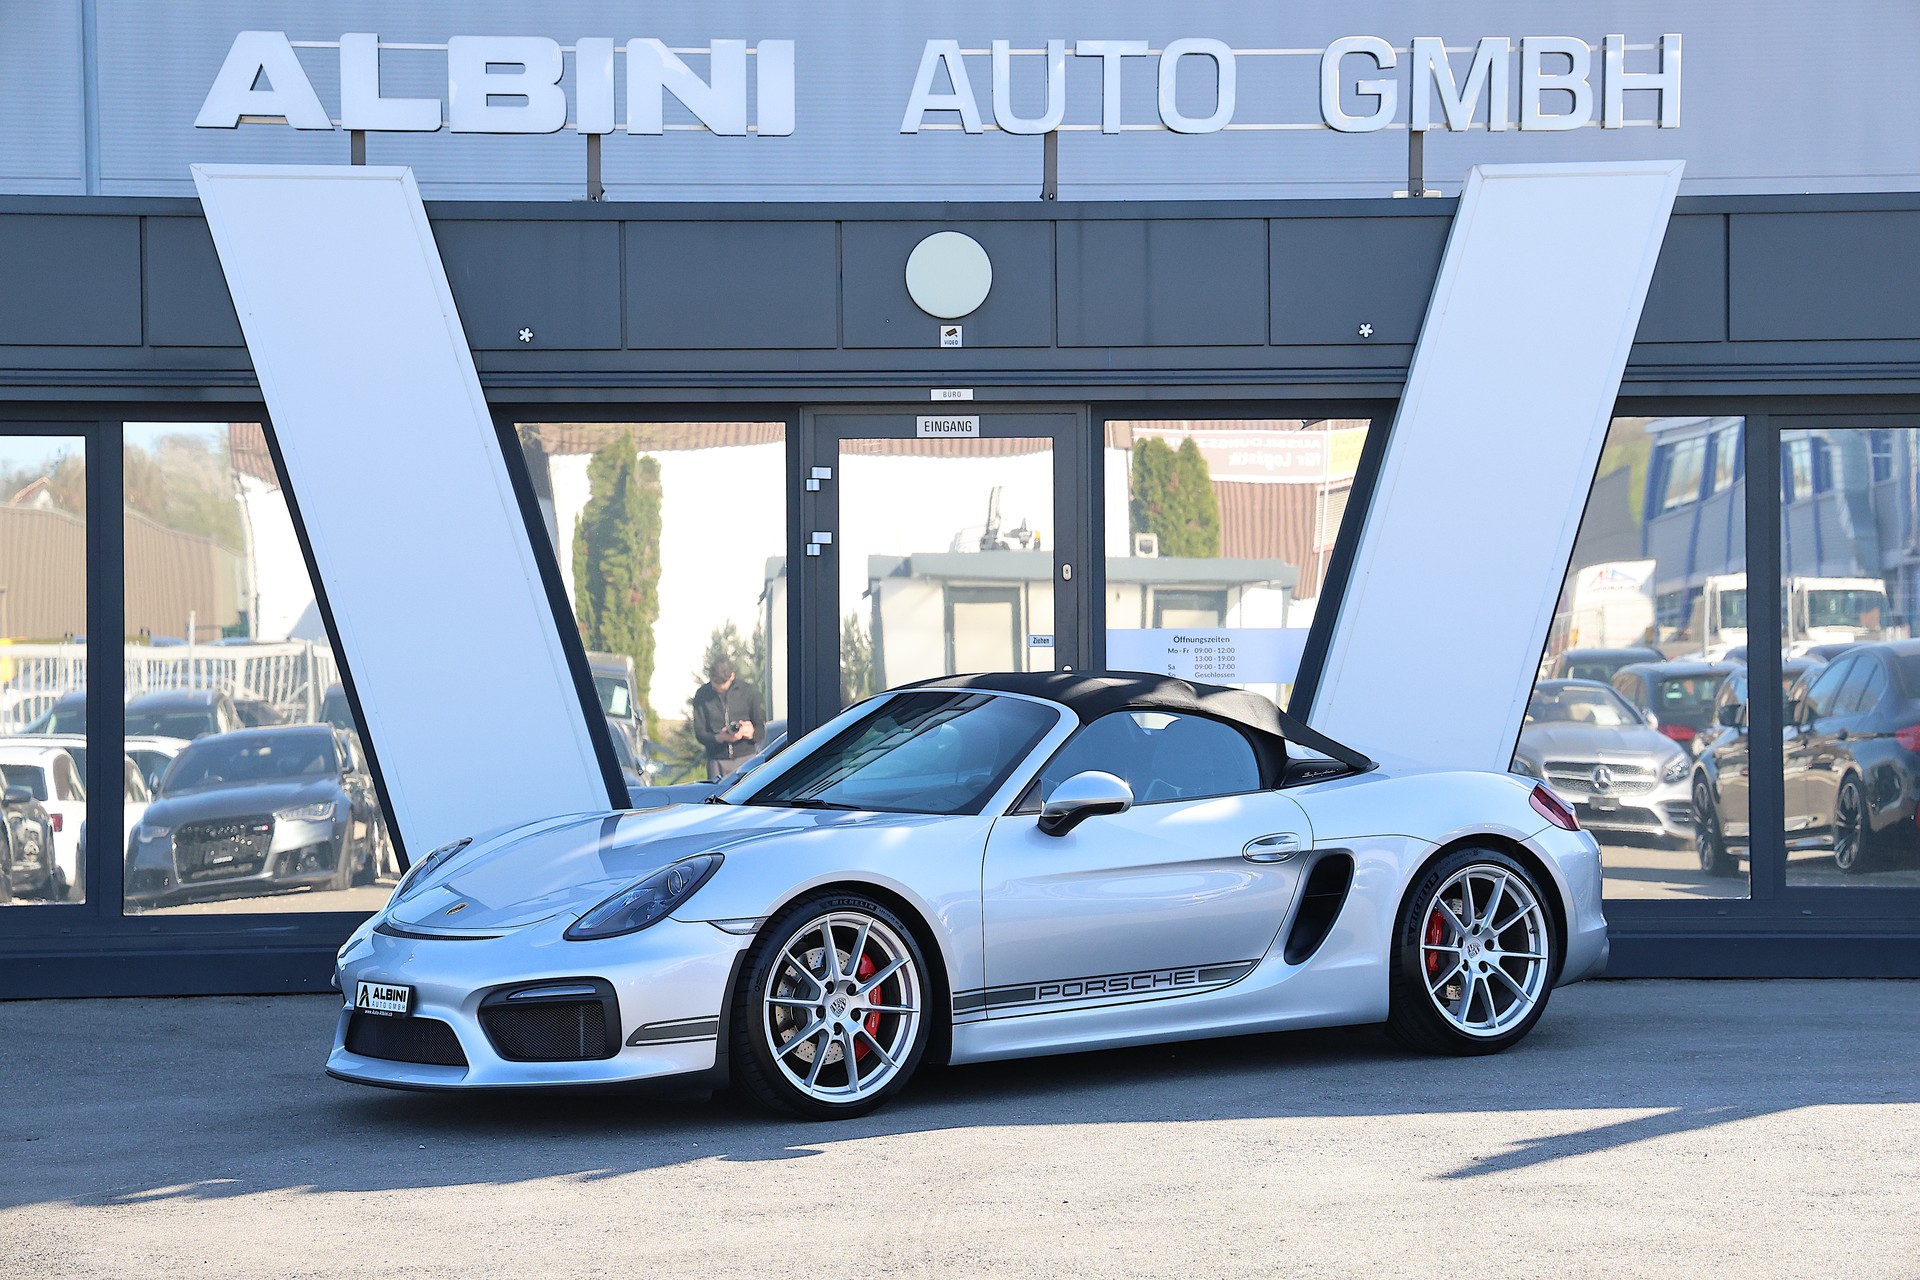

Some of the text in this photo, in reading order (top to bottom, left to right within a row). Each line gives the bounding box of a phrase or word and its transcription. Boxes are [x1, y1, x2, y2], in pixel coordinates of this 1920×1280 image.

[193, 30, 1683, 136] ALBINI AUTO GMBH
[924, 420, 972, 432] EINGANG
[1173, 635, 1230, 644] Öffnungszeiten
[832, 899, 875, 910] MICHELIN
[1038, 970, 1196, 1000] PORSCHE
[373, 987, 407, 1002] ALBINI
[372, 1000, 406, 1011] AUTO GMBH
